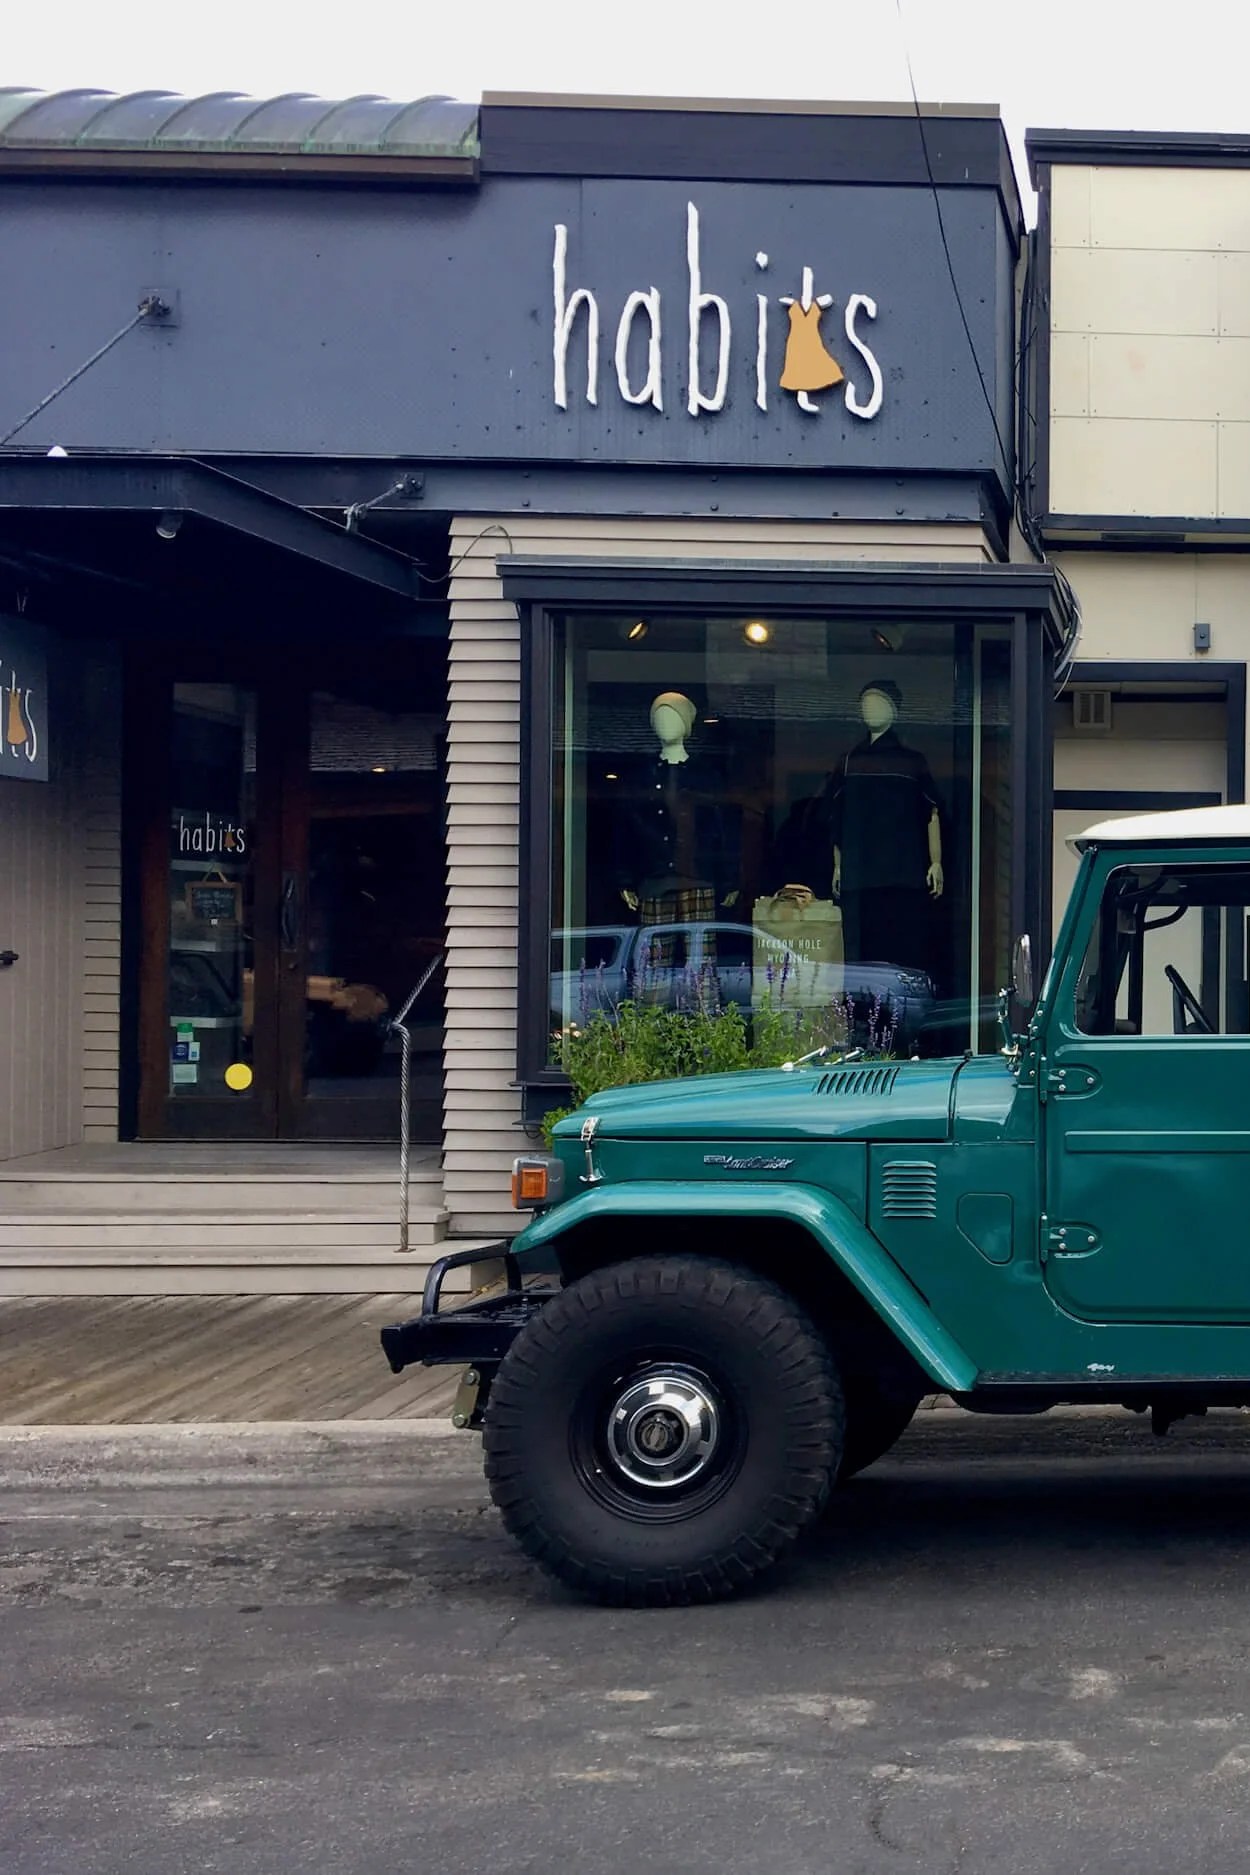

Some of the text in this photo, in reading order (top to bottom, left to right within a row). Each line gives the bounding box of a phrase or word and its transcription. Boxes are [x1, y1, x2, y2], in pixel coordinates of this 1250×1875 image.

[552, 200, 884, 420] habits
[180, 811, 246, 853] habits
[798, 939, 822, 950] HOLE
